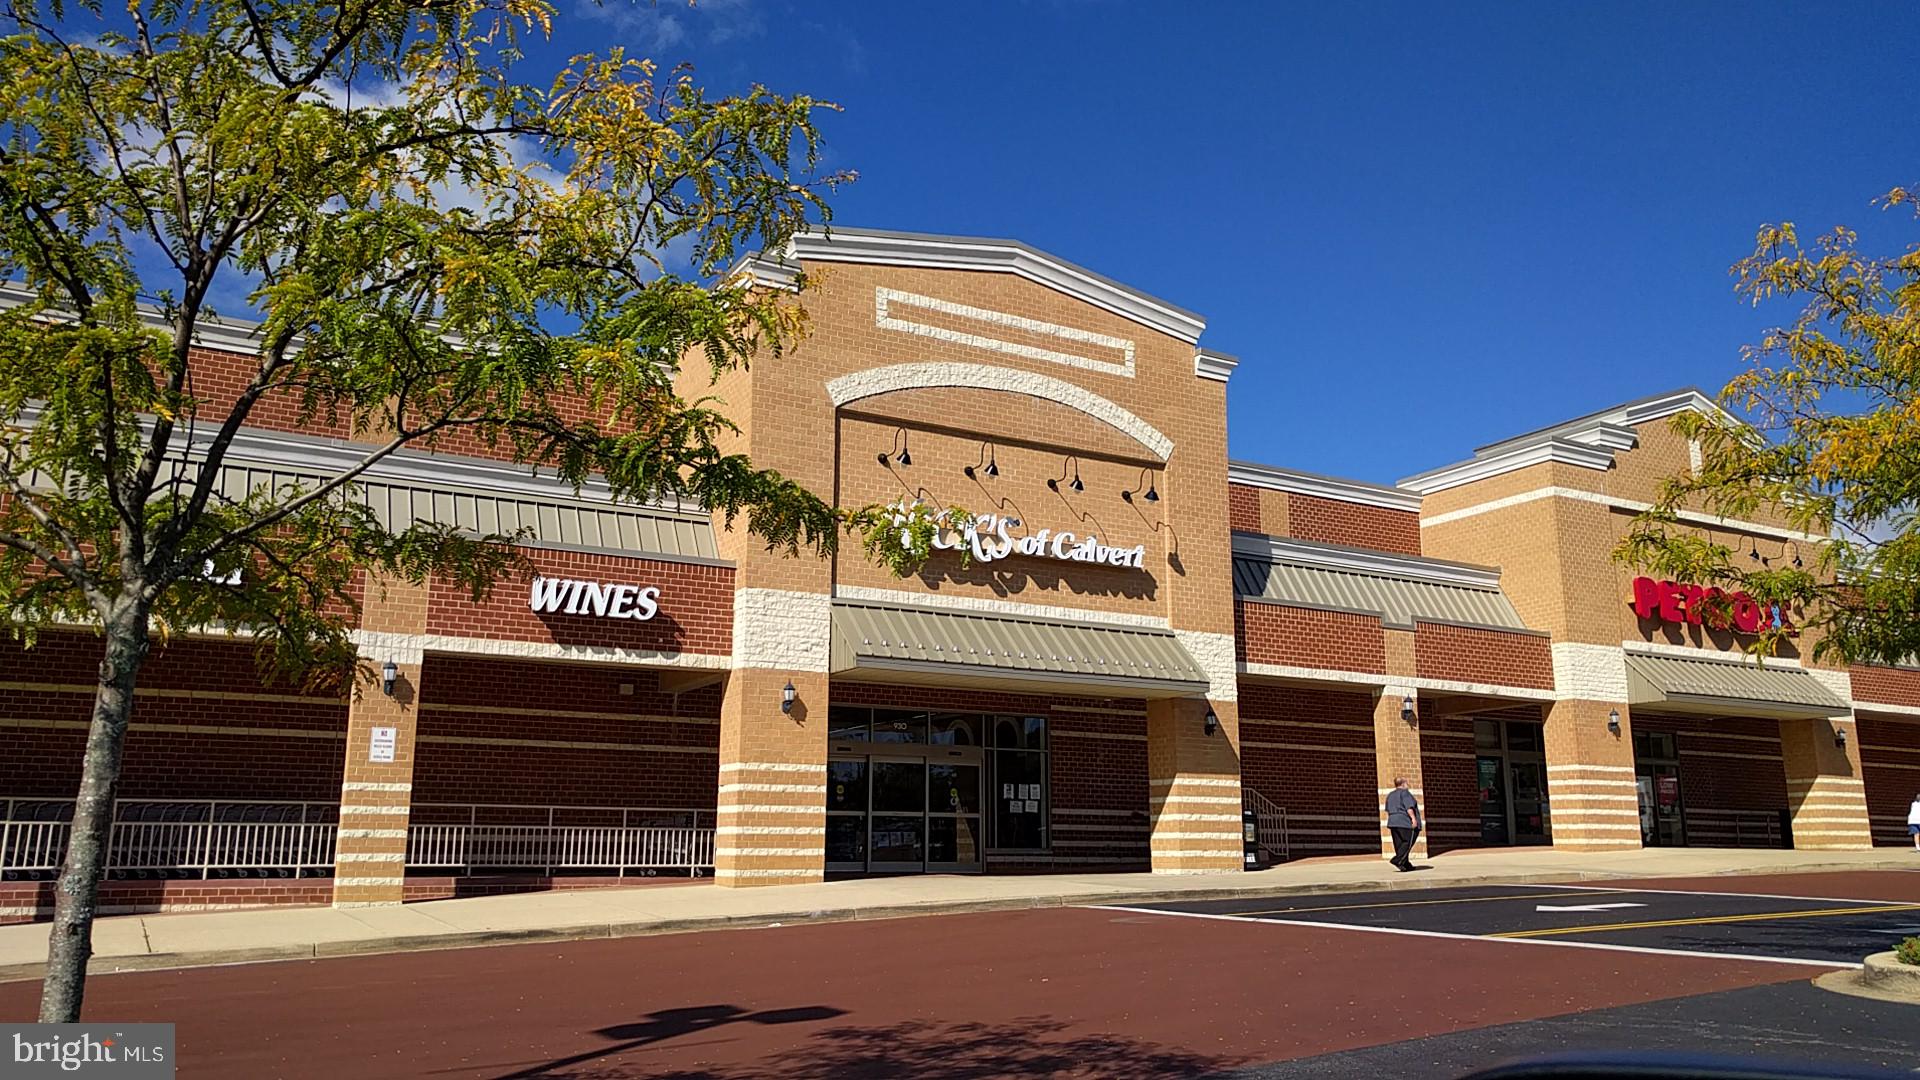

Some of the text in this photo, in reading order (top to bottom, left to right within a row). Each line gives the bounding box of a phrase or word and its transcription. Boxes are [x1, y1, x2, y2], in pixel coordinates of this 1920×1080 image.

[884, 499, 1146, 569] CK'S of Calvert
[531, 576, 661, 621] WINES
